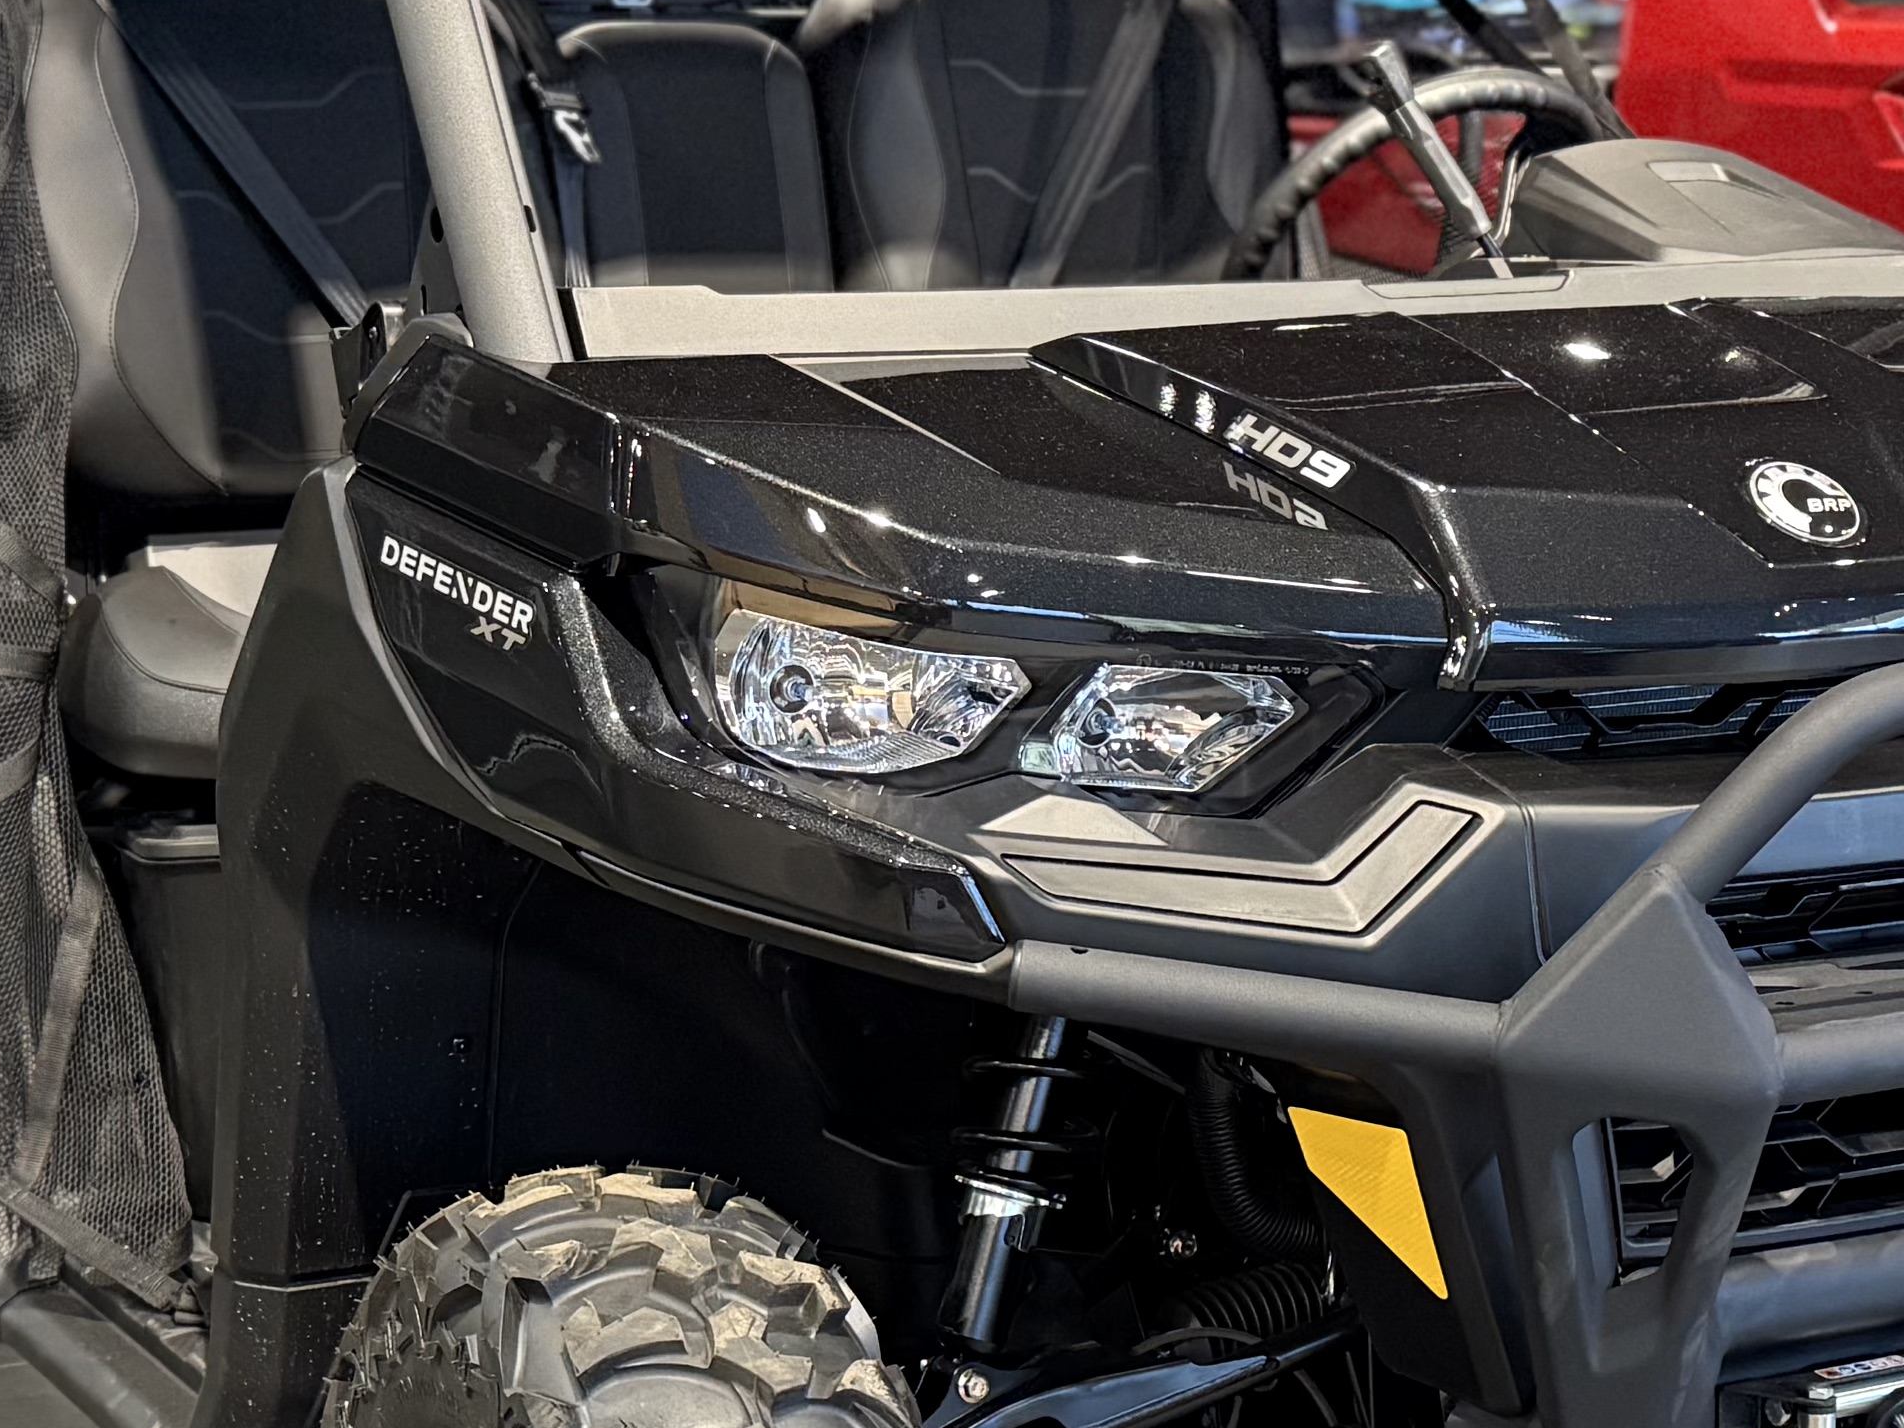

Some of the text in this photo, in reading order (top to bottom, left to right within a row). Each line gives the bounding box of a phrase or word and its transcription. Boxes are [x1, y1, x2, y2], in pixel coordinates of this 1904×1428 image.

[1224, 412, 1351, 489] HD9
[1807, 494, 1851, 513] BRP
[379, 534, 536, 634] DEFENDER
[469, 615, 527, 652] XT
